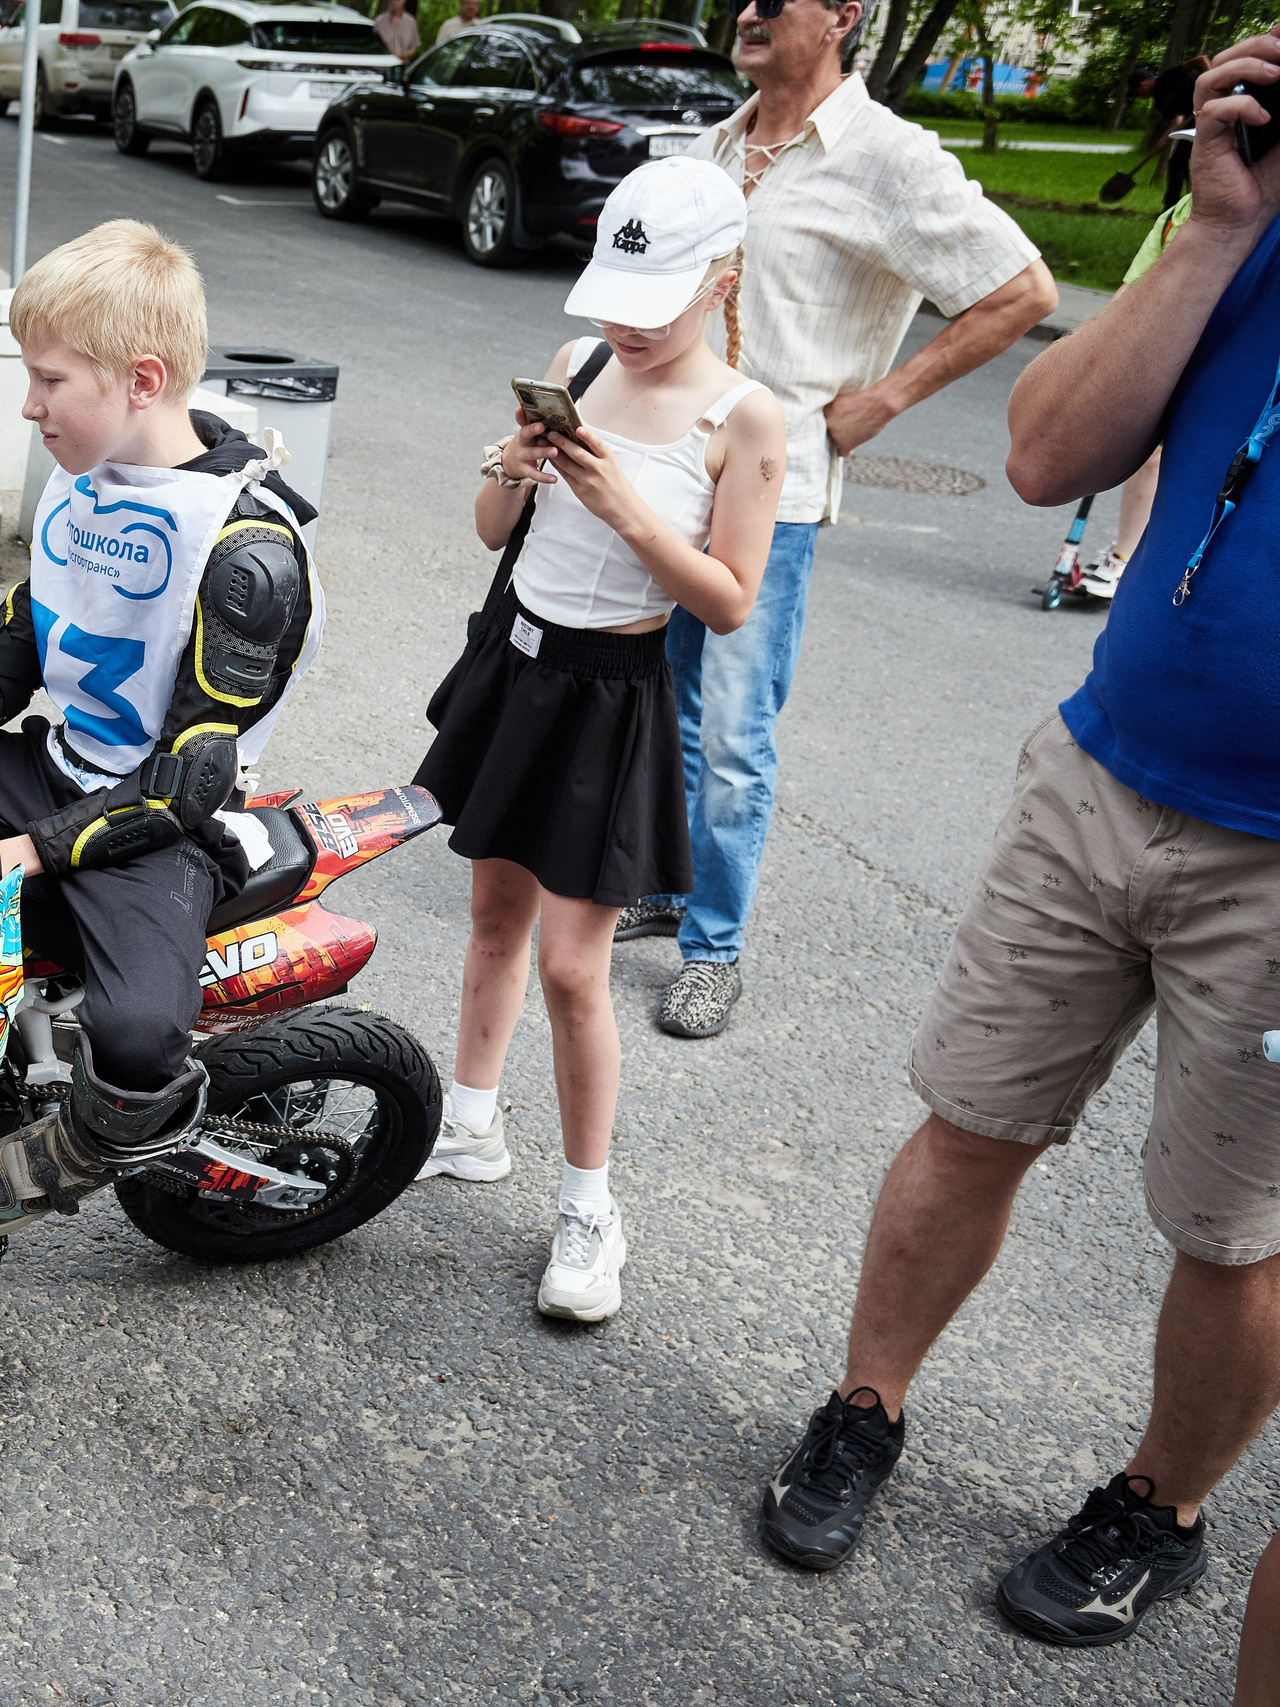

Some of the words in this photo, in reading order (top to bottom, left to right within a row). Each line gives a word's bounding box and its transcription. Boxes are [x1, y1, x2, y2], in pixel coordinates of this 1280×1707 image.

[612, 235, 647, 254] Kappa
[300, 802, 343, 859] BSE
[325, 813, 360, 860] EVO
